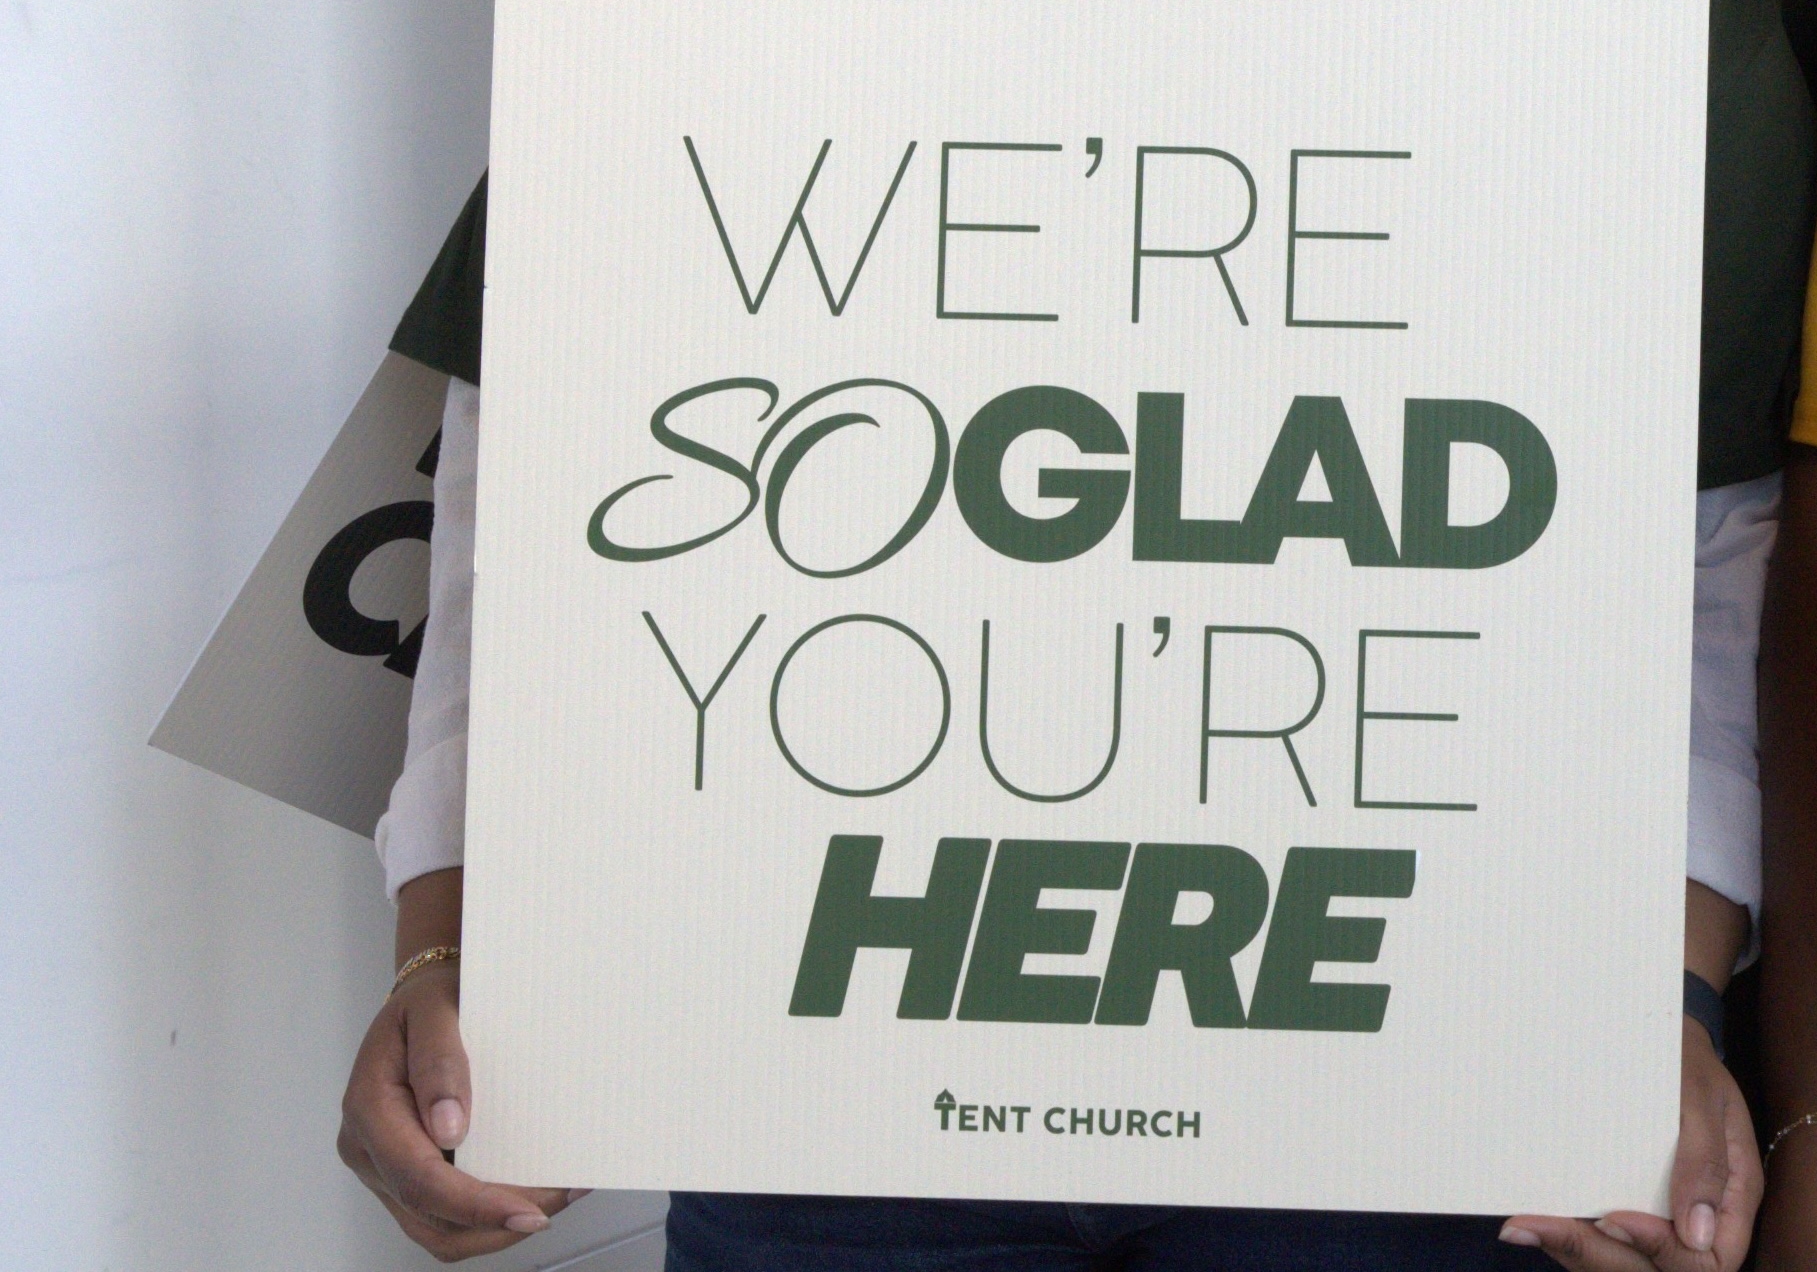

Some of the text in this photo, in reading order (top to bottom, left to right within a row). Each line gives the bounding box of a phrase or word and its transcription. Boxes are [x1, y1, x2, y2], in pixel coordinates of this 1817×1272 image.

[683, 135, 1412, 330] WE’RE
[641, 611, 1481, 812] YOU’RE
[787, 834, 1417, 1034] HERE
[933, 1088, 1201, 1139] TENT CHURCH
